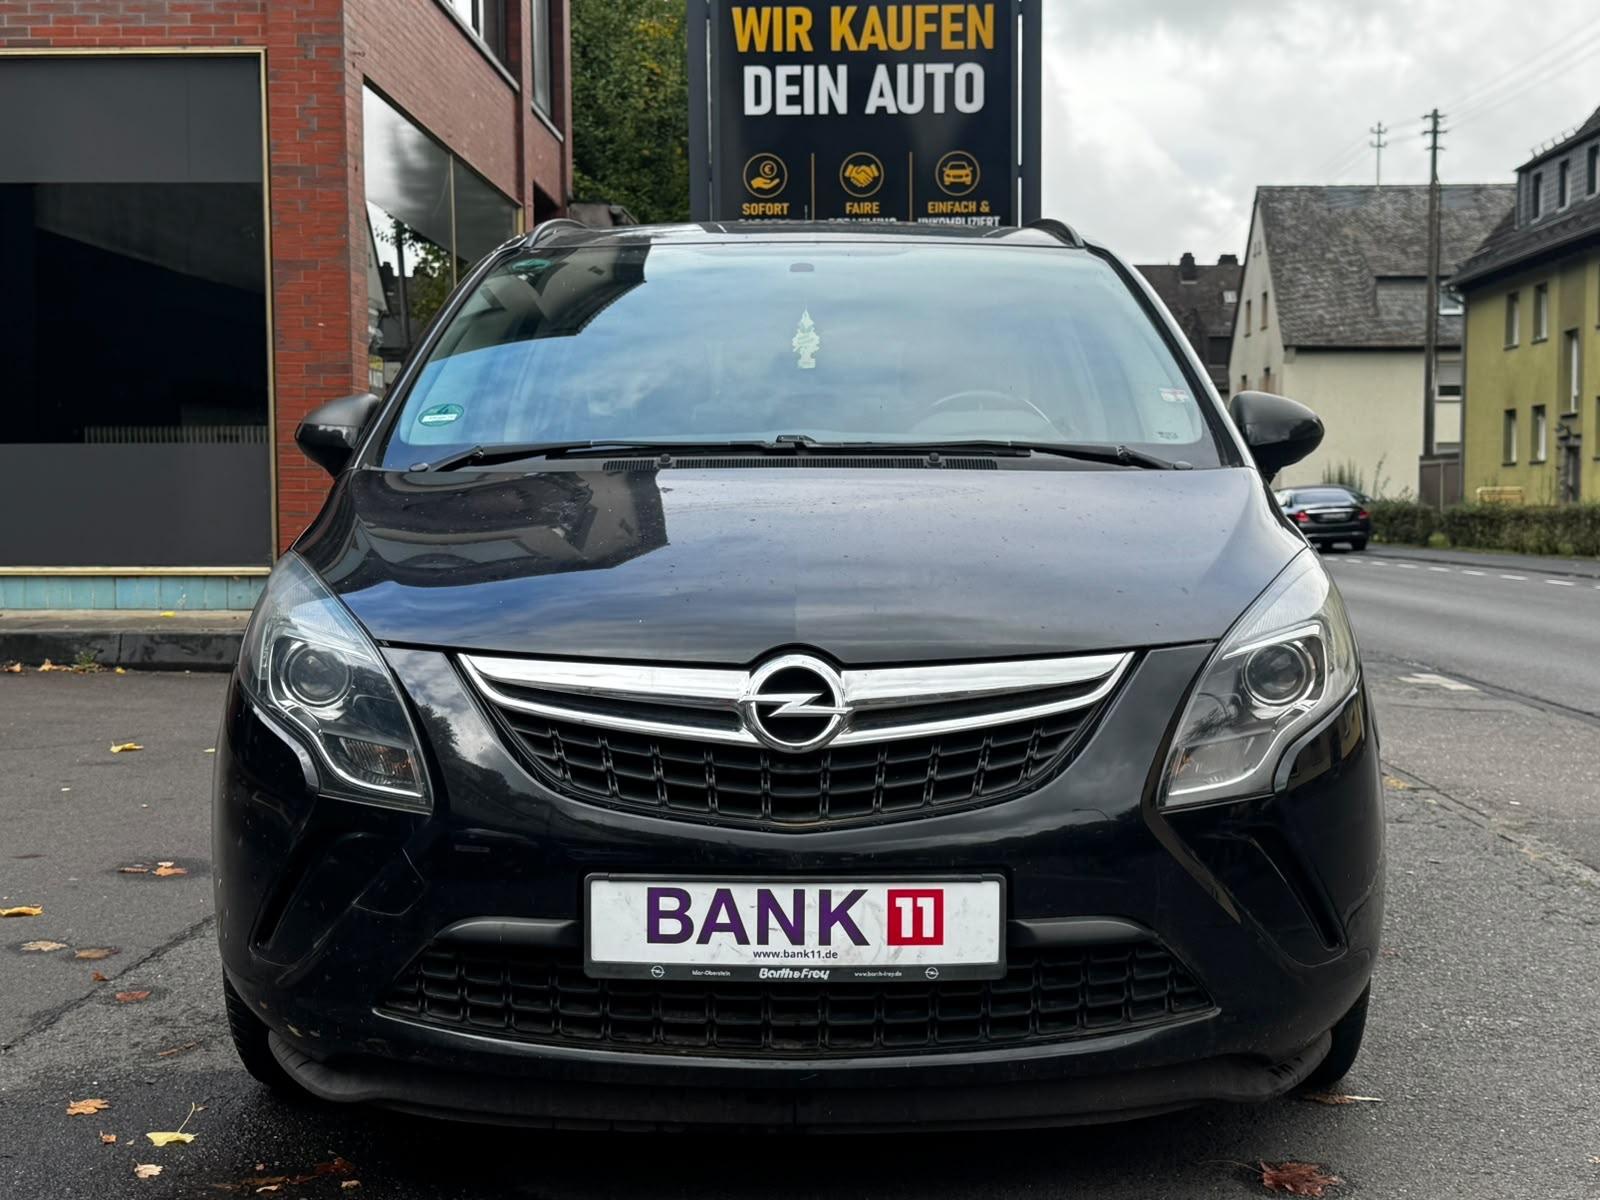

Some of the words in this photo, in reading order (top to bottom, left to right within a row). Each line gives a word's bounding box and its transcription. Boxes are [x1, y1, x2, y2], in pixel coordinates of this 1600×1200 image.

[731, 6, 813, 53] WIR
[830, 4, 995, 52] KAUFEN
[743, 64, 848, 116] DEIN
[865, 62, 985, 115] AUTO
[742, 202, 790, 215] SOFORT
[845, 202, 880, 214] FAIRE
[927, 201, 977, 213] EINFACH
[979, 200, 990, 213] &
[646, 887, 871, 946] BANK
[895, 896, 936, 939] 11
[752, 949, 838, 959] www.bank11.de
